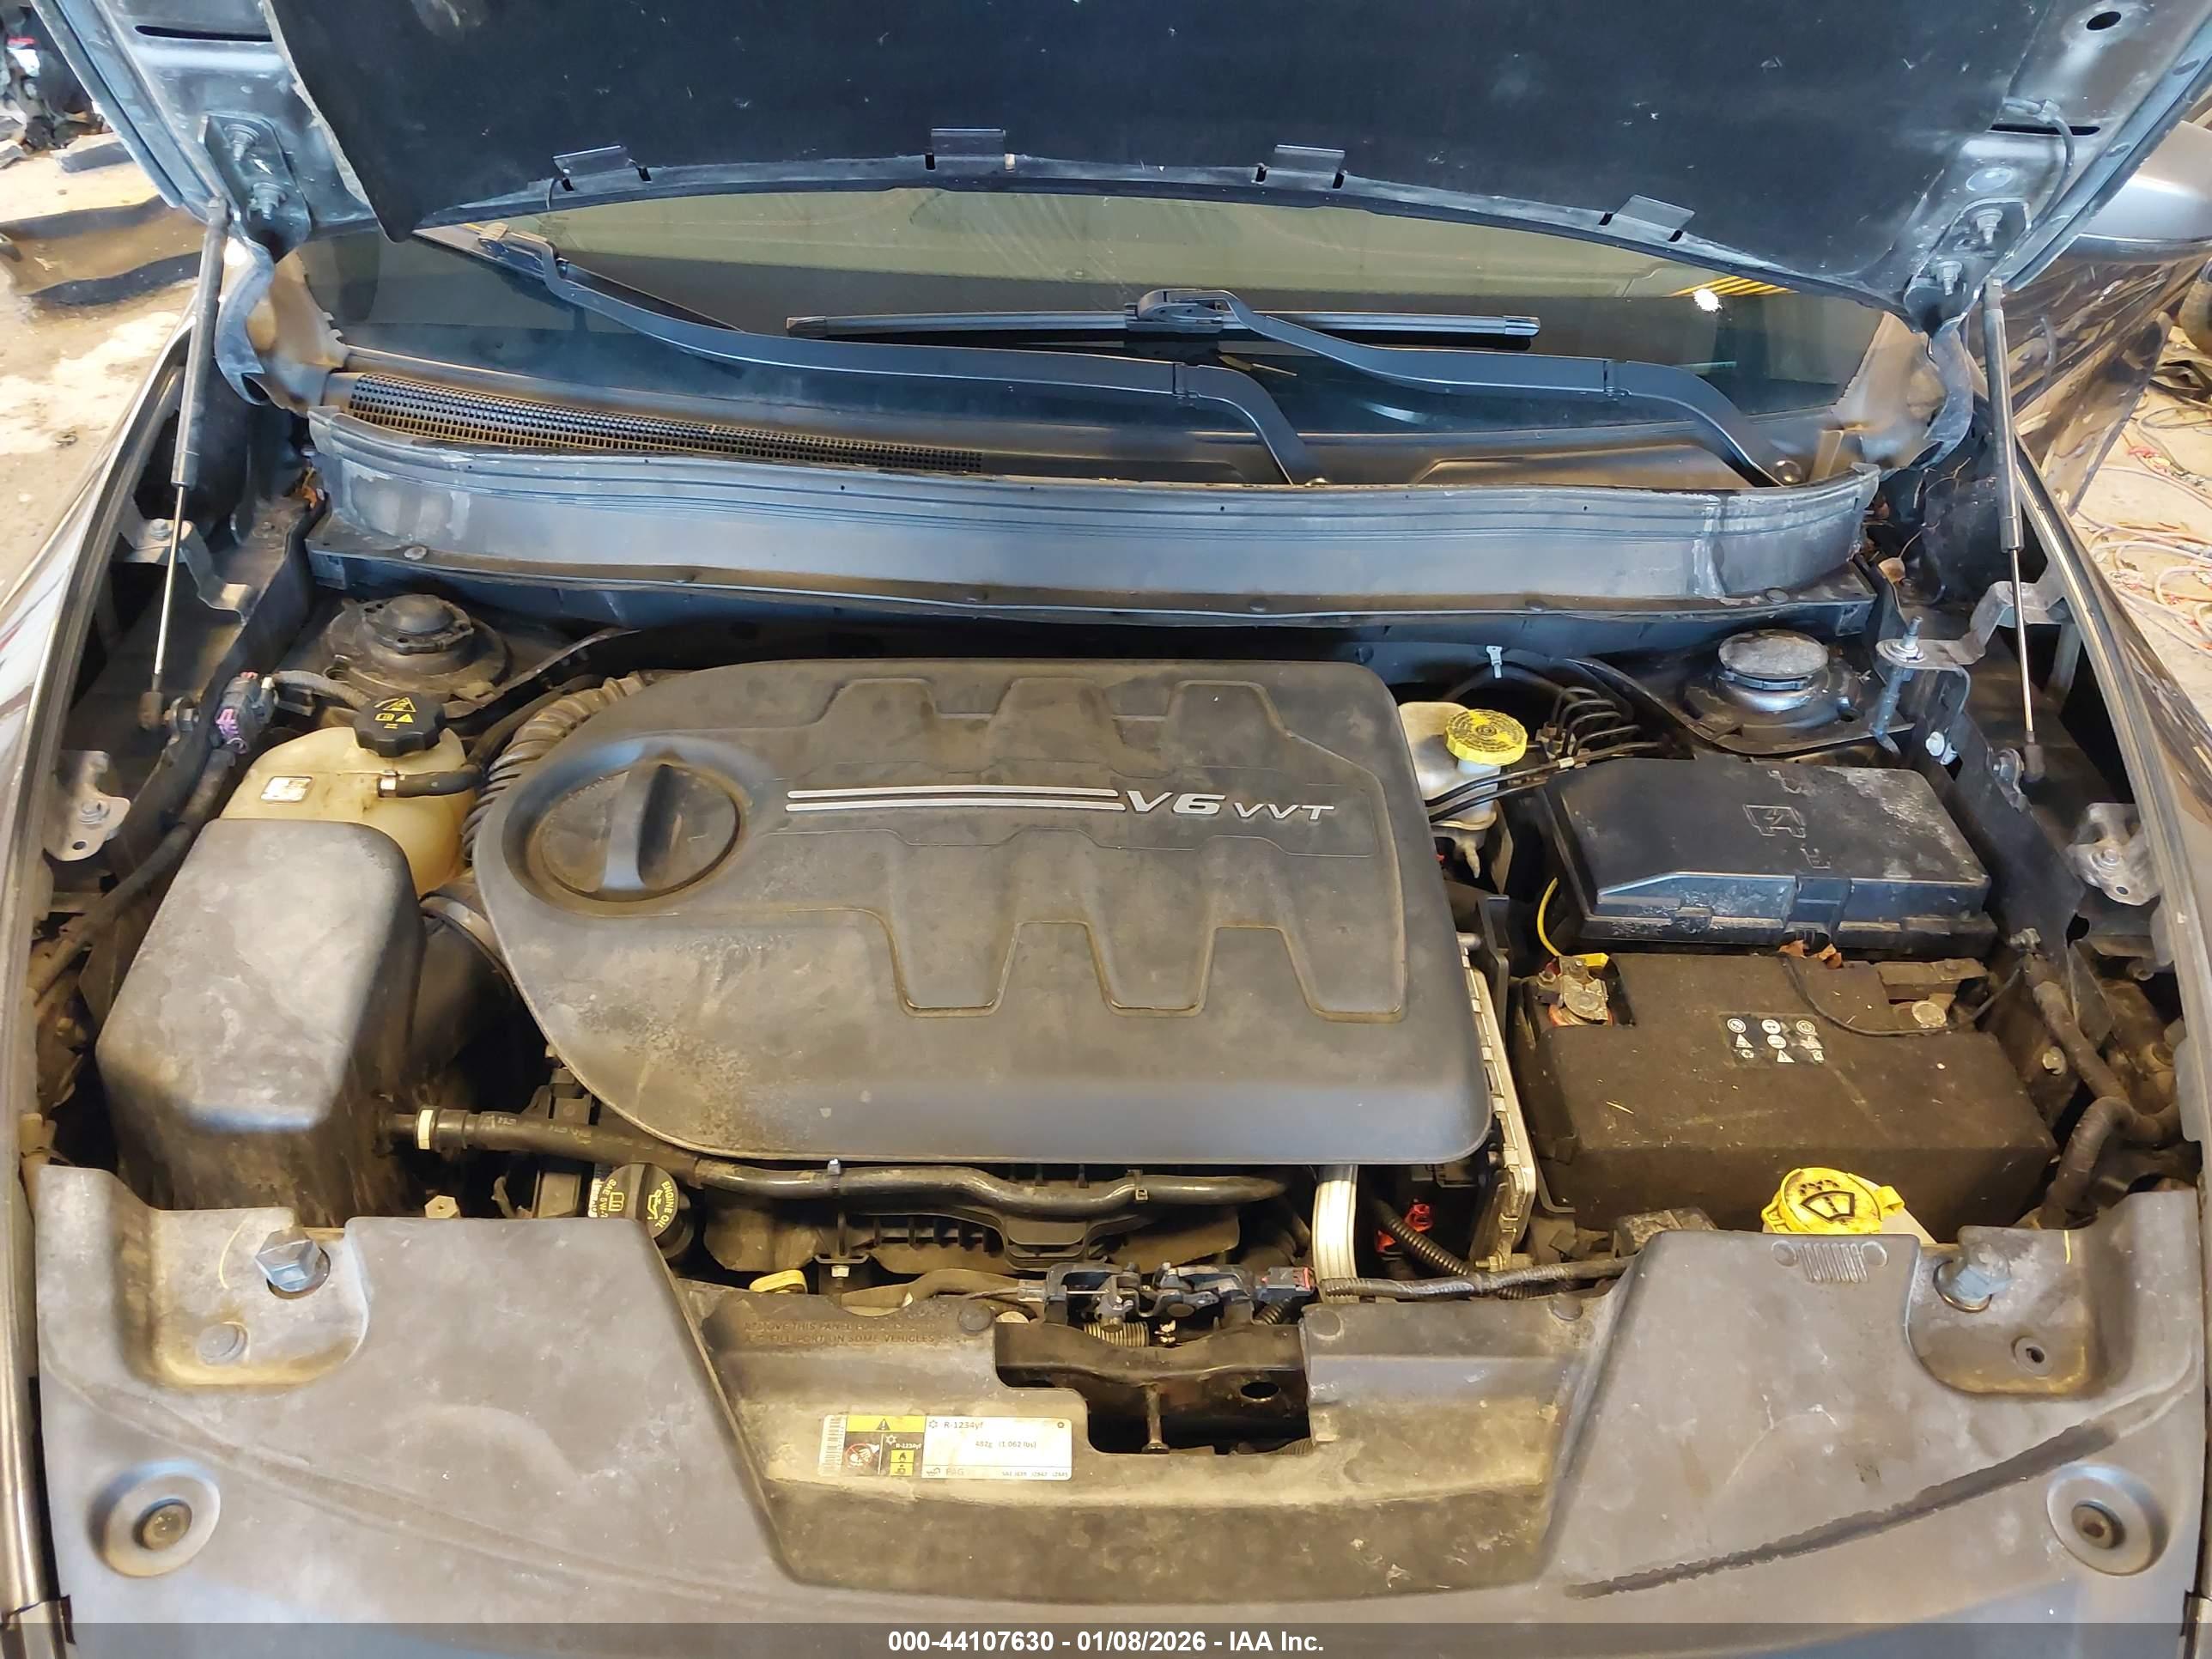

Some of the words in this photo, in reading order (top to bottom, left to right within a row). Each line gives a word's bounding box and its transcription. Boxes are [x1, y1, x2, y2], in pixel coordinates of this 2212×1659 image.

[1126, 790, 1226, 815] V6
[1233, 802, 1335, 821] VVT
[602, 1178, 617, 1196] SAE
[660, 1181, 675, 1214] ENGINE
[654, 1214, 670, 1229] OIL
[792, 1321, 817, 1330] THIS
[848, 1334, 878, 1342] SOME
[944, 1421, 984, 1431] R-1234yf
